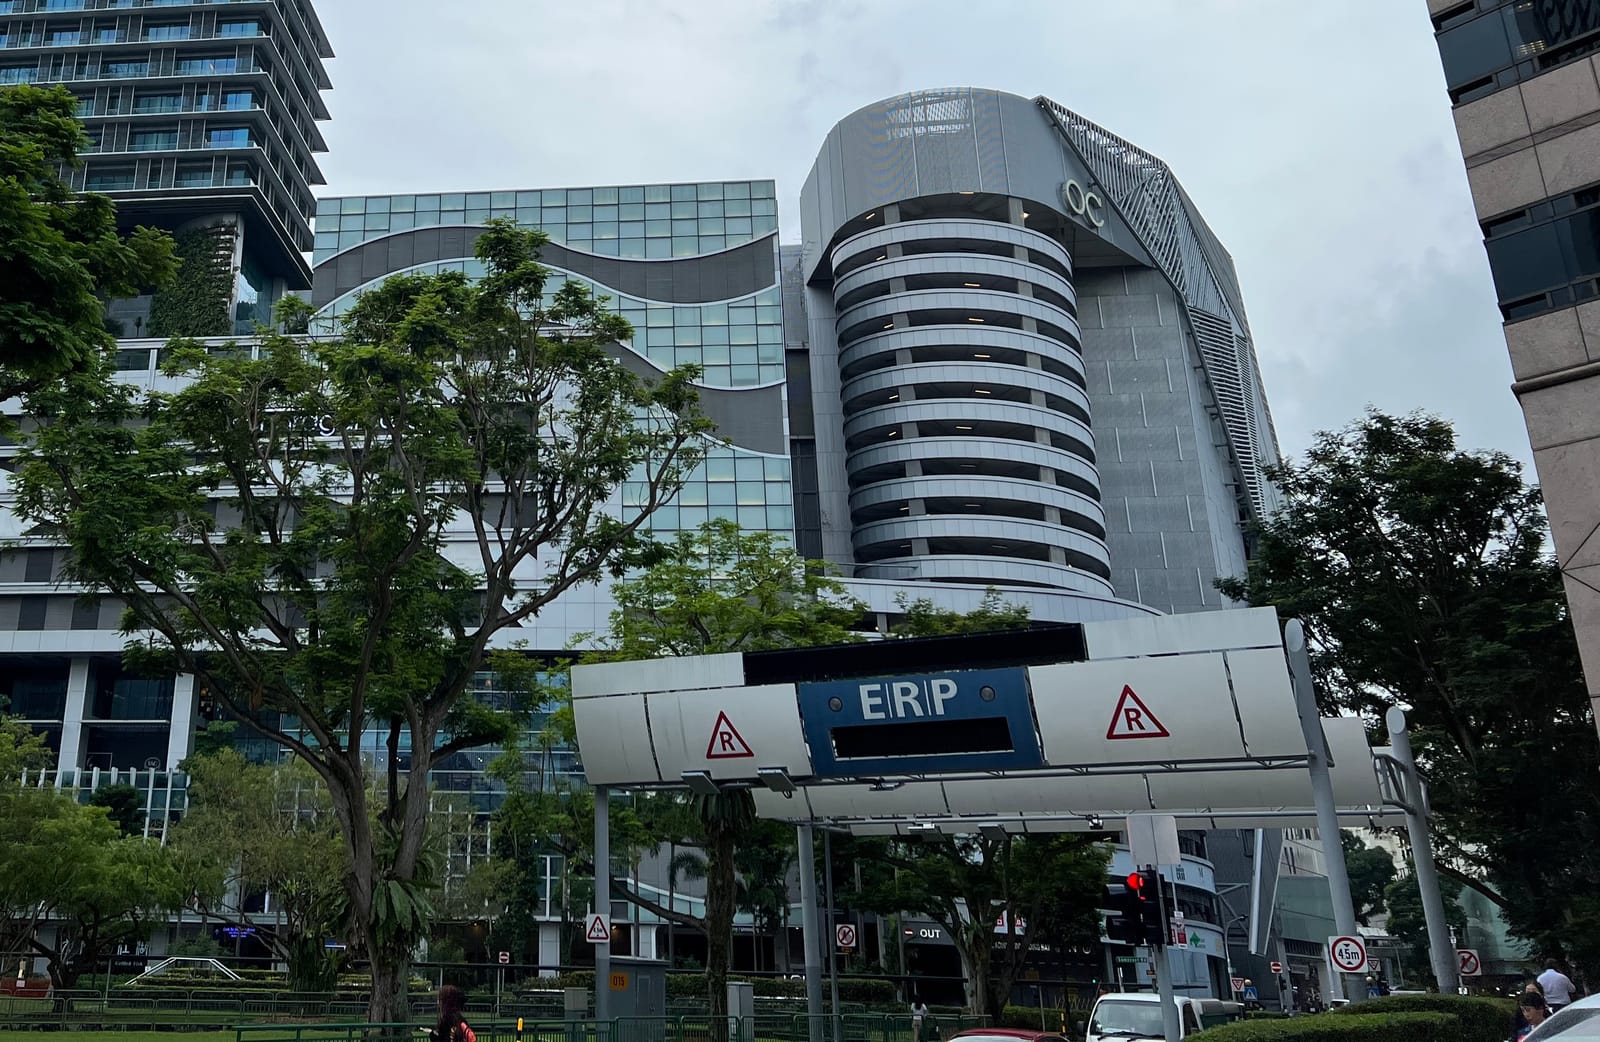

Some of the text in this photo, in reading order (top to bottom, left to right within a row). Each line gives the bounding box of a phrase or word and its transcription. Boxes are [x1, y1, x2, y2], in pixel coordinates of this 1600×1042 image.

[1064, 178, 1105, 228] OC
[859, 679, 958, 720] ERP
[1123, 707, 1146, 731] R
[719, 730, 736, 752] R
[919, 928, 941, 939] OUT
